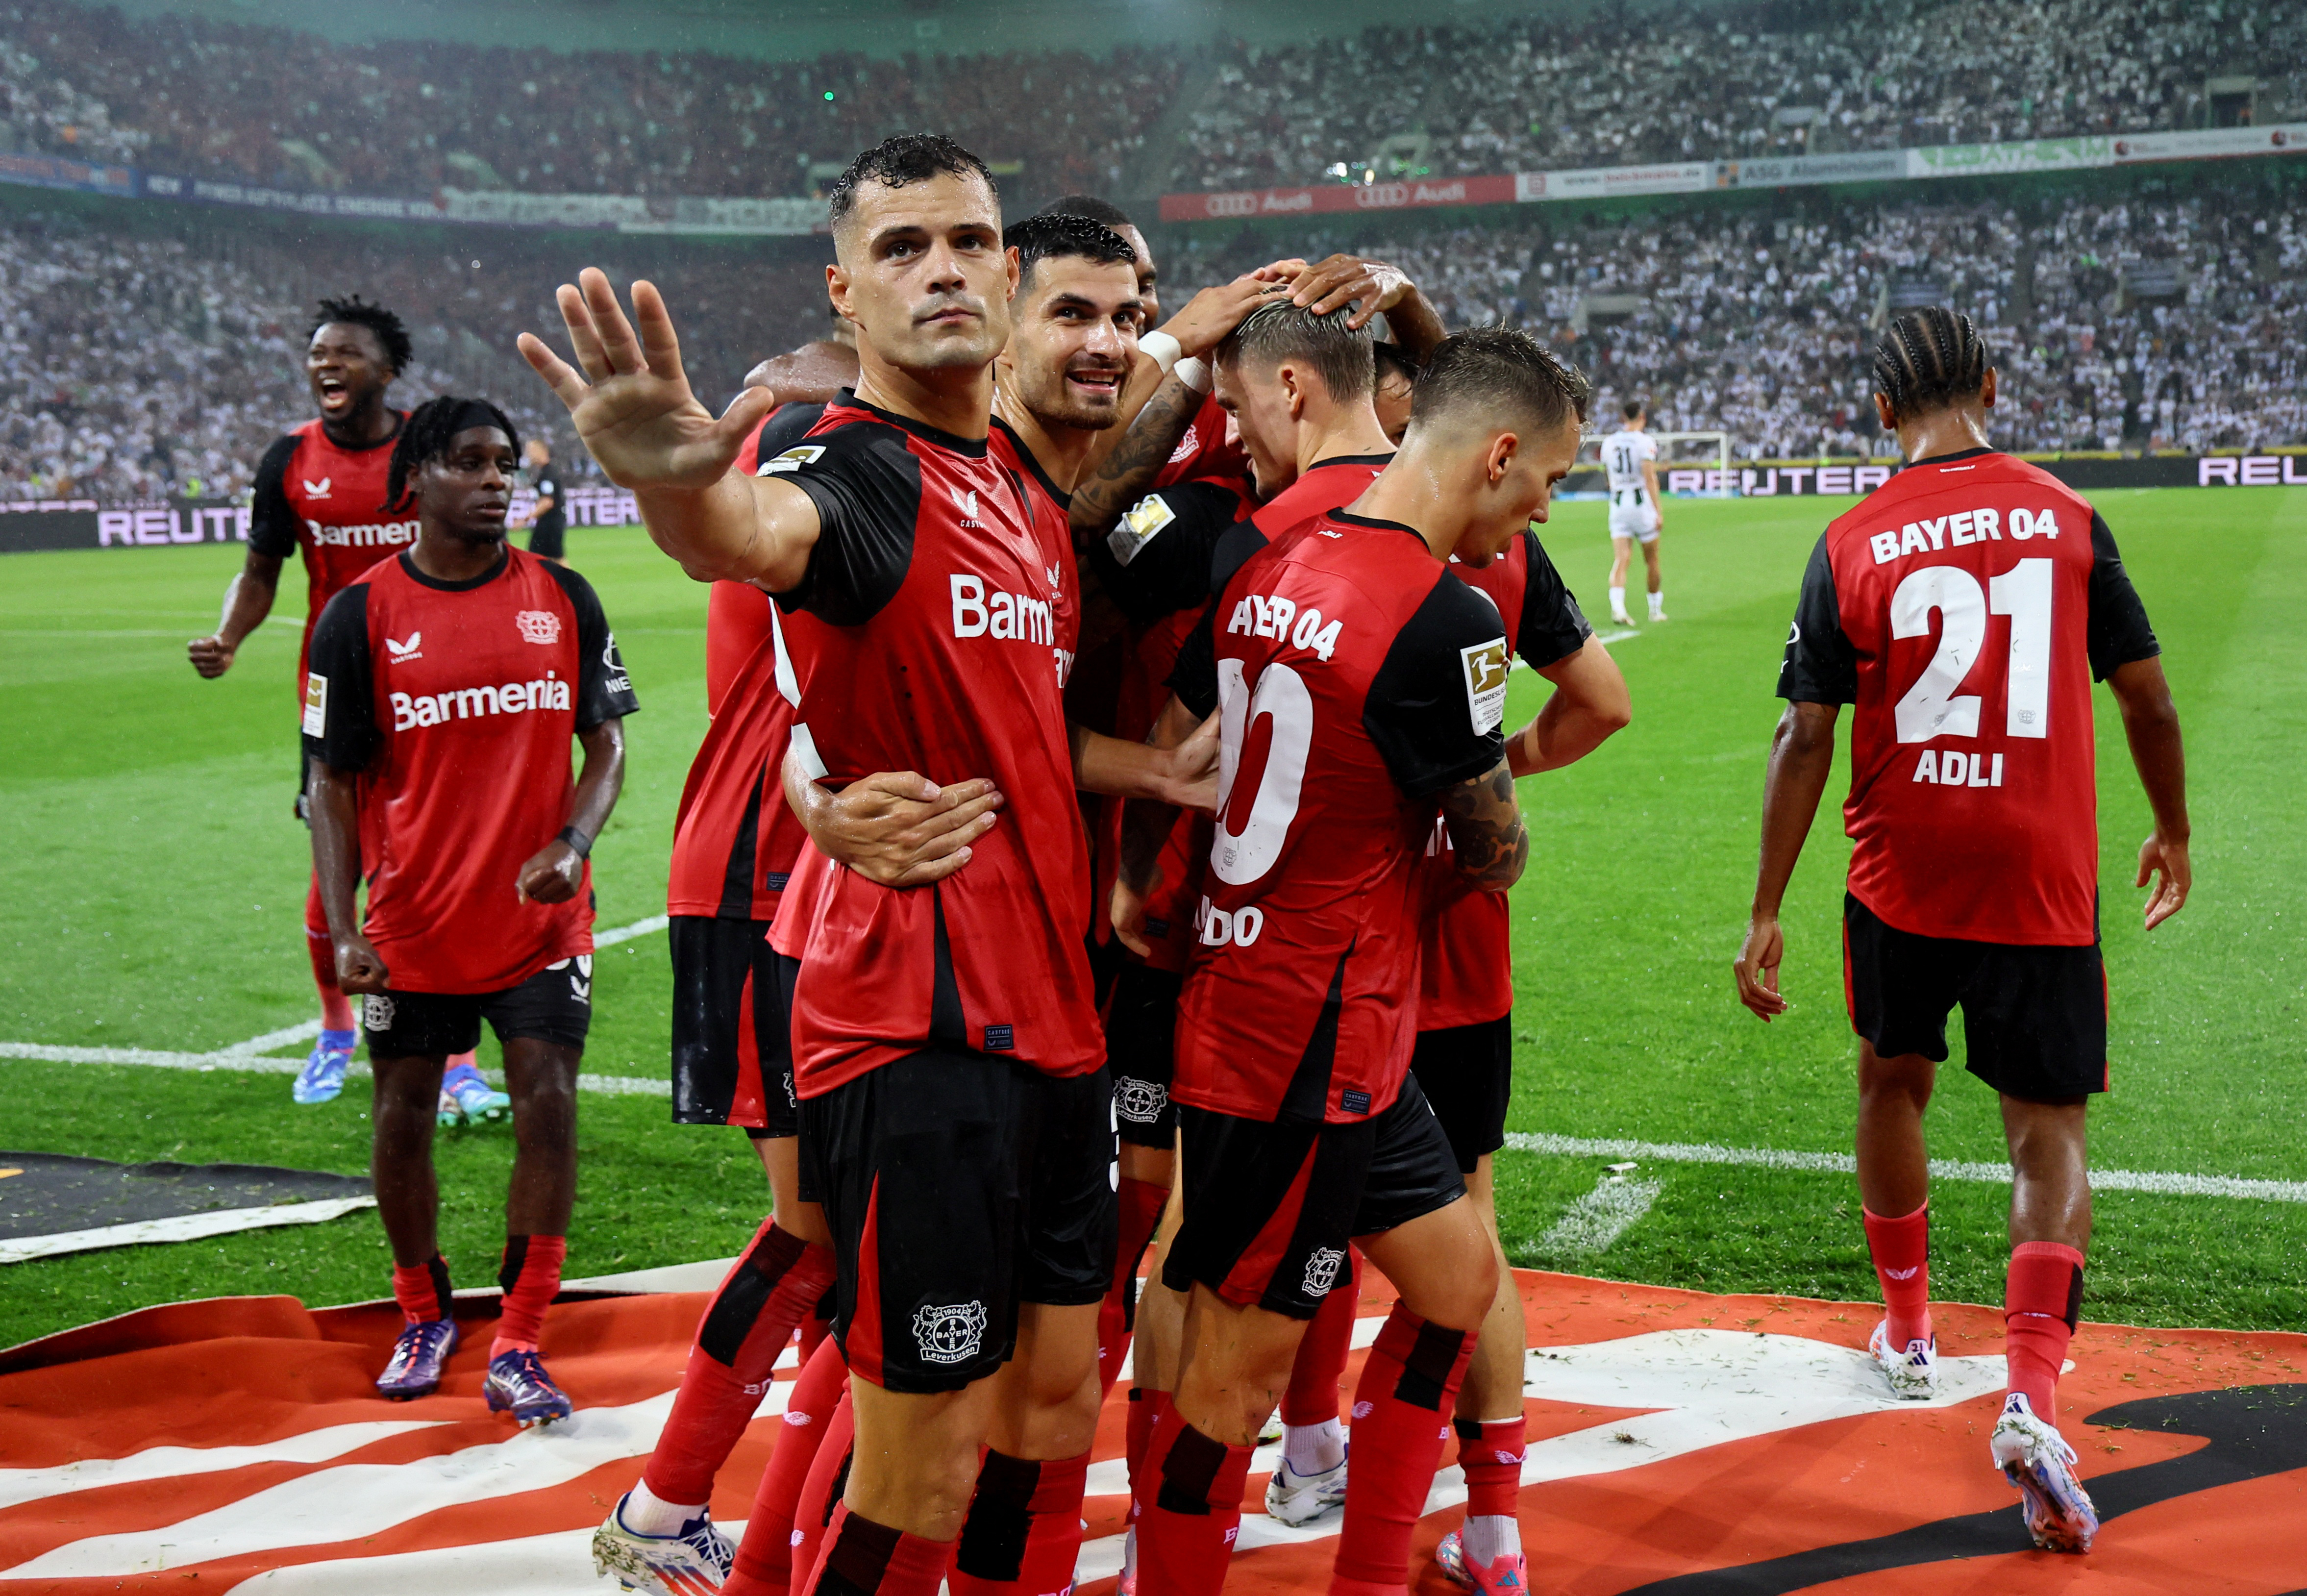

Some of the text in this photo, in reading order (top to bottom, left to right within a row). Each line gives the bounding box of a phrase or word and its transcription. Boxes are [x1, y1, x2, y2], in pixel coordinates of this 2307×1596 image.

[1263, 192, 1312, 211] Audi
[1414, 183, 1465, 202] Audi
[1870, 508, 2059, 565] BAYER 04
[1292, 608, 1343, 662] 04
[1890, 557, 2053, 744] 21
[389, 670, 571, 731] Barmenia
[1912, 749, 2004, 787] ADLI
[943, 1308, 962, 1316] 1904
[936, 1329, 968, 1339] BAYER
[925, 1347, 975, 1361] Leverkusen
